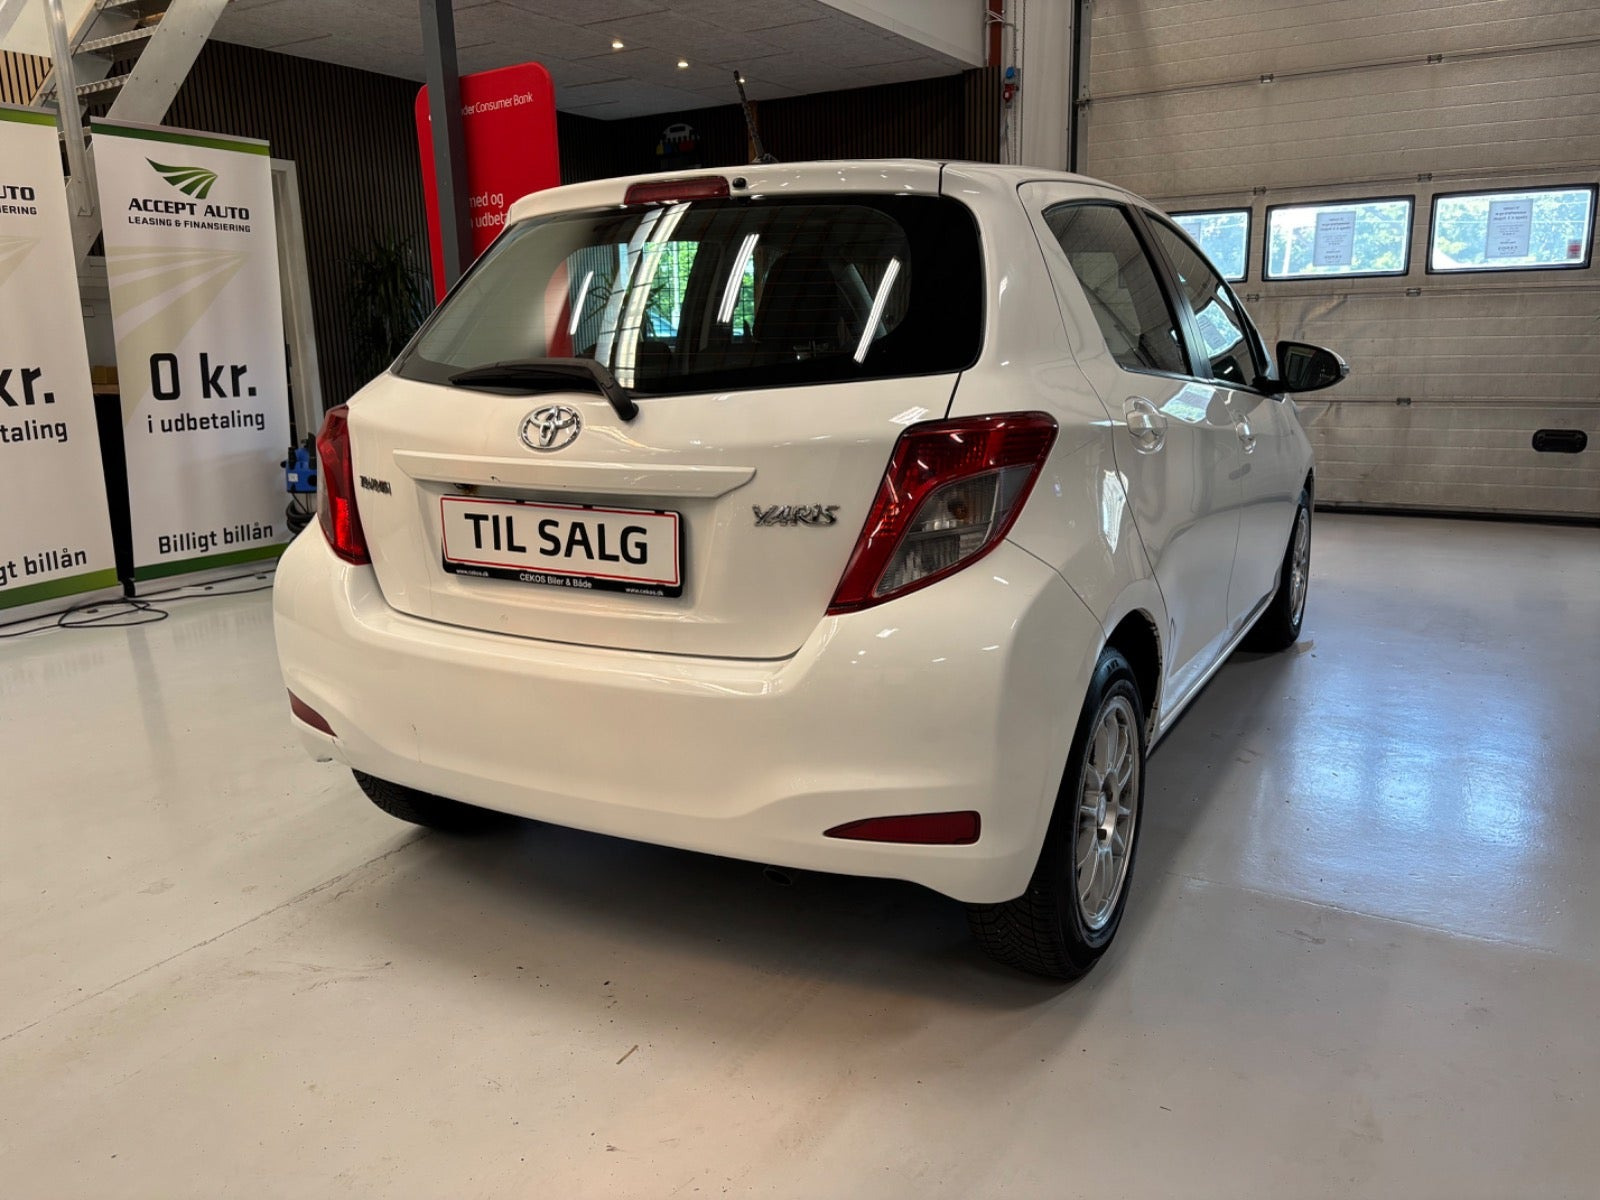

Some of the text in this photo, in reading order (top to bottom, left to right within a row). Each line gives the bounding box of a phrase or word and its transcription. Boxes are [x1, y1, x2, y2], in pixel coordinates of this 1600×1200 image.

[475, 98, 512, 113] Consumer
[513, 91, 533, 106] Bank
[128, 198, 250, 220] ACCEPT AUTO
[491, 193, 504, 208] og
[128, 216, 172, 227] LEASING
[184, 220, 251, 233] FINANSIERING
[150, 353, 257, 400] 0 kr.
[147, 410, 265, 434] i udbetaling
[752, 503, 840, 527] YARIS
[159, 522, 273, 554] Billigt billån
[464, 513, 648, 565] TIL SALG
[23, 547, 87, 576] billån
[519, 573, 547, 584] CEKOS
[547, 577, 564, 586] Biler
[573, 578, 592, 588] Både
